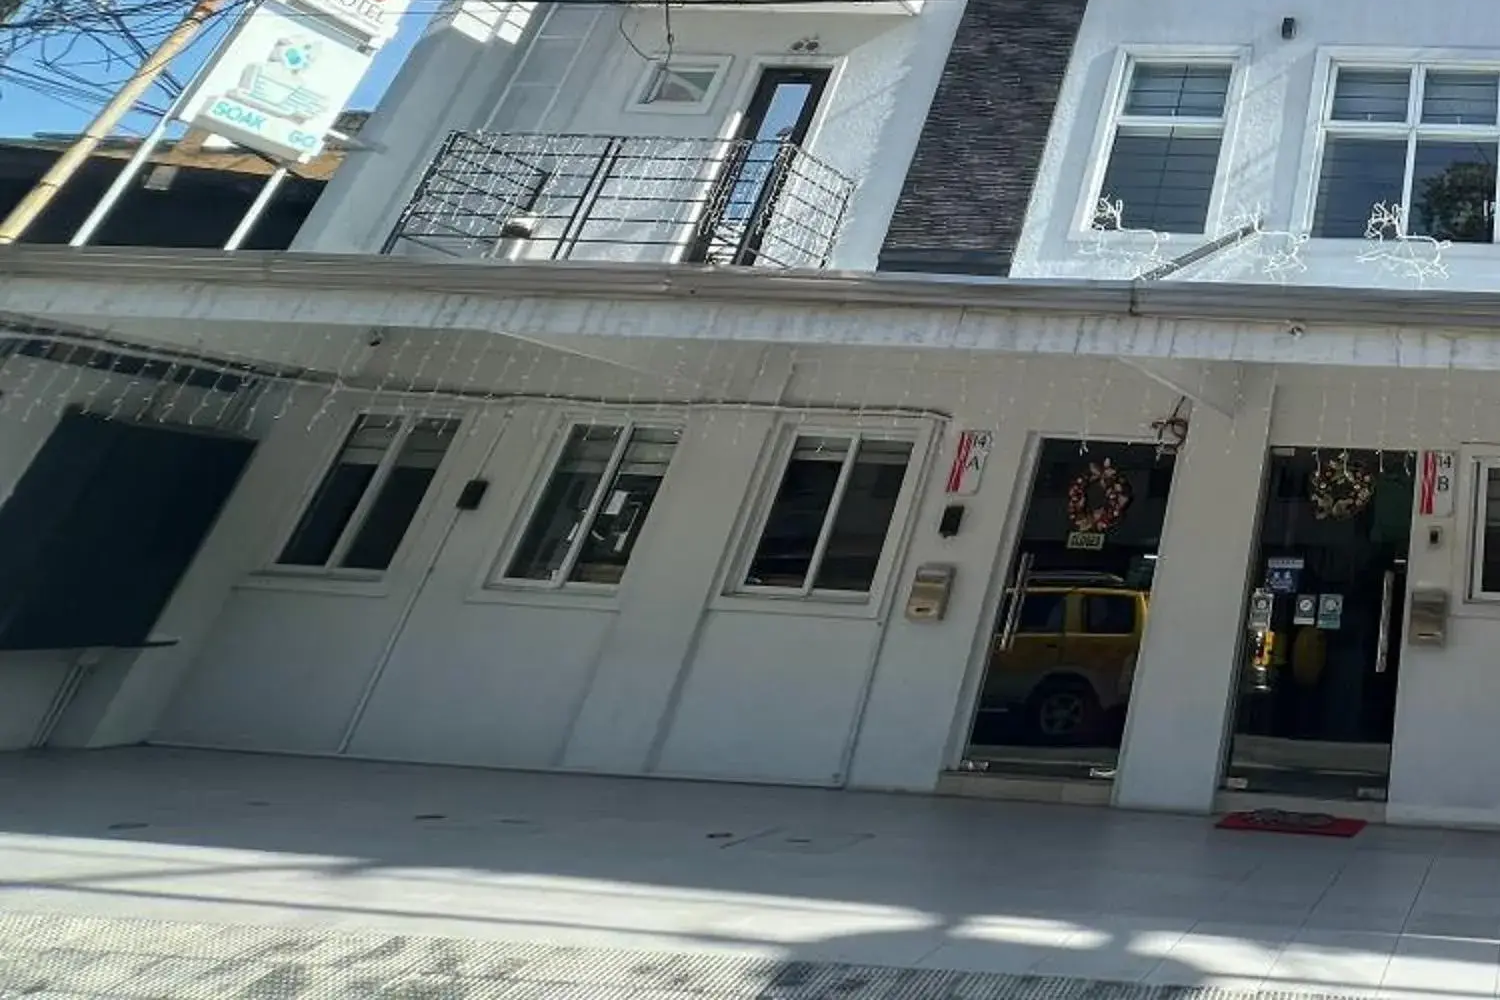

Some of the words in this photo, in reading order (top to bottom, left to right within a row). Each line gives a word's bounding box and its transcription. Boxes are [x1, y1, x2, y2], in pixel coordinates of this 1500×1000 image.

[212, 101, 265, 130] SOAK
[288, 130, 316, 147] GO
[1437, 475, 1449, 491] B
